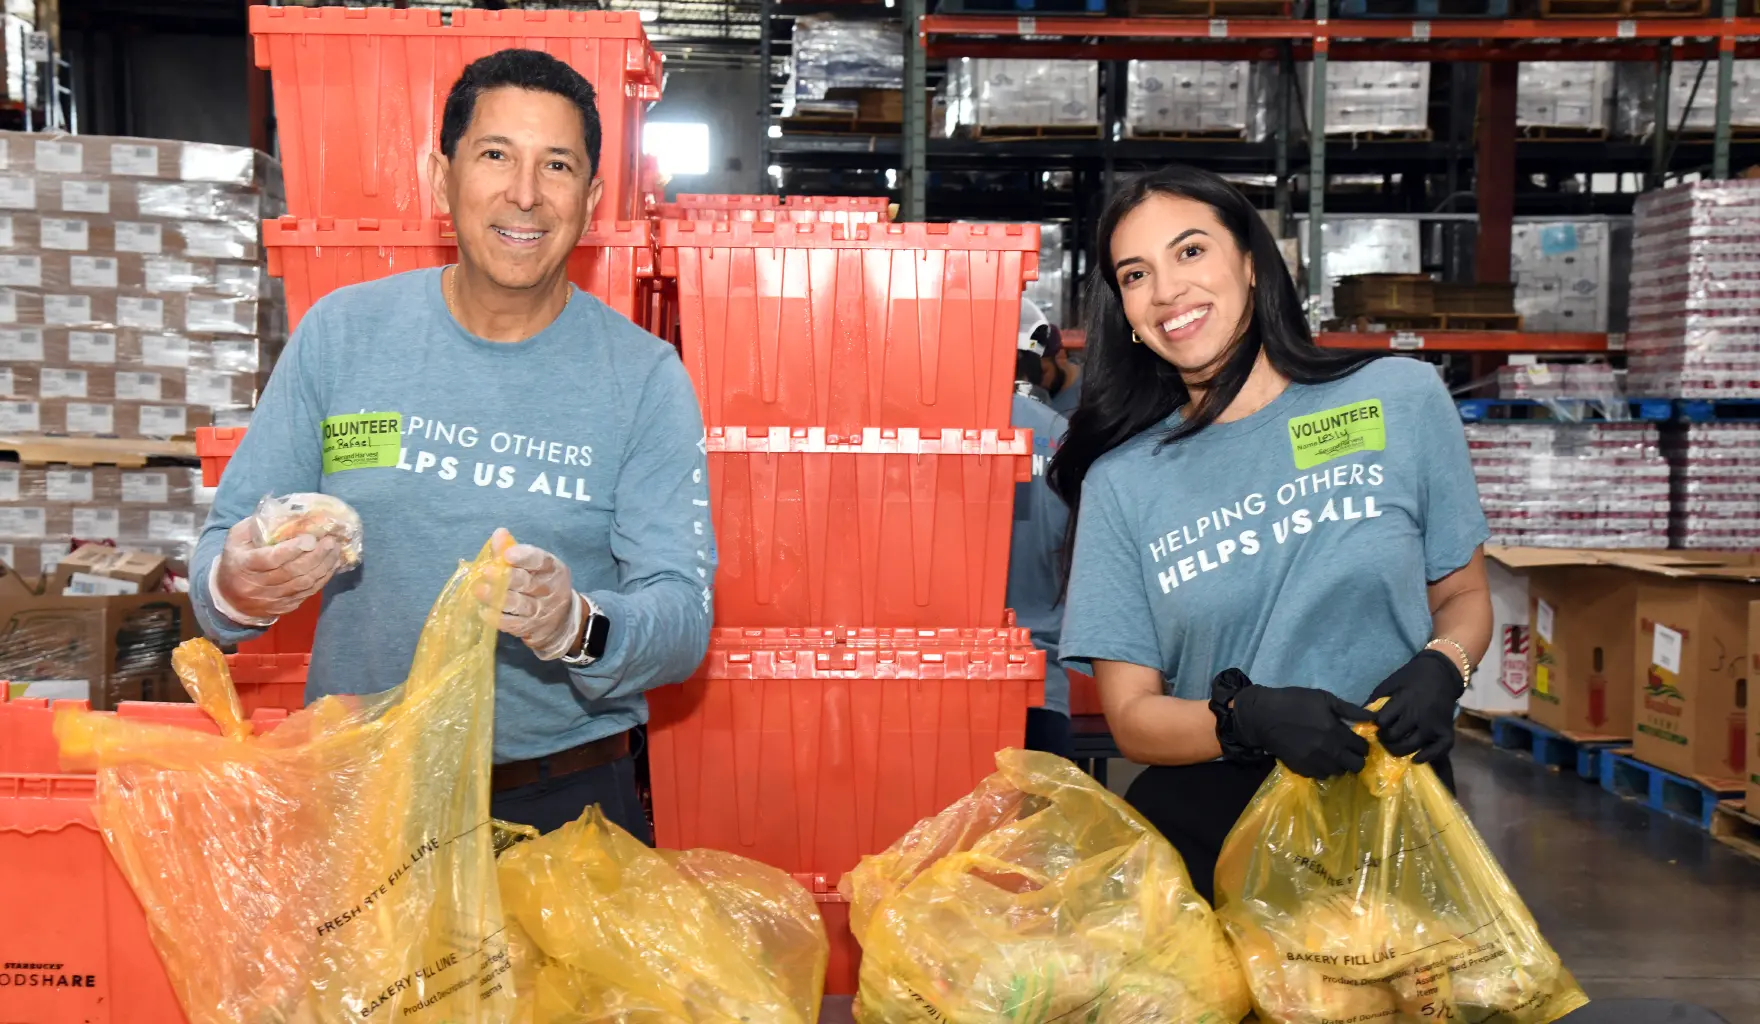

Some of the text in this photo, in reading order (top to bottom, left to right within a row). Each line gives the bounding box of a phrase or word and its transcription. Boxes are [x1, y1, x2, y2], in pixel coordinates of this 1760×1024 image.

[324, 419, 398, 439] OLUNTEER
[1292, 406, 1379, 439] VOLUNTEER
[490, 431, 593, 467] OTHERS
[396, 446, 592, 502] LPS US ALL
[1149, 463, 1385, 562] HELPING OTHERS
[1157, 496, 1383, 595] HELPS US ALL
[316, 904, 362, 937] FRESH
[388, 862, 411, 886] FILL
[411, 837, 440, 863] LINE
[4, 962, 64, 970] STARBUCKS
[1286, 947, 1397, 966] BAKERY FILL LINE
[360, 974, 413, 1018] BAKERY
[436, 952, 459, 972] LINE
[402, 994, 438, 1017] Product
